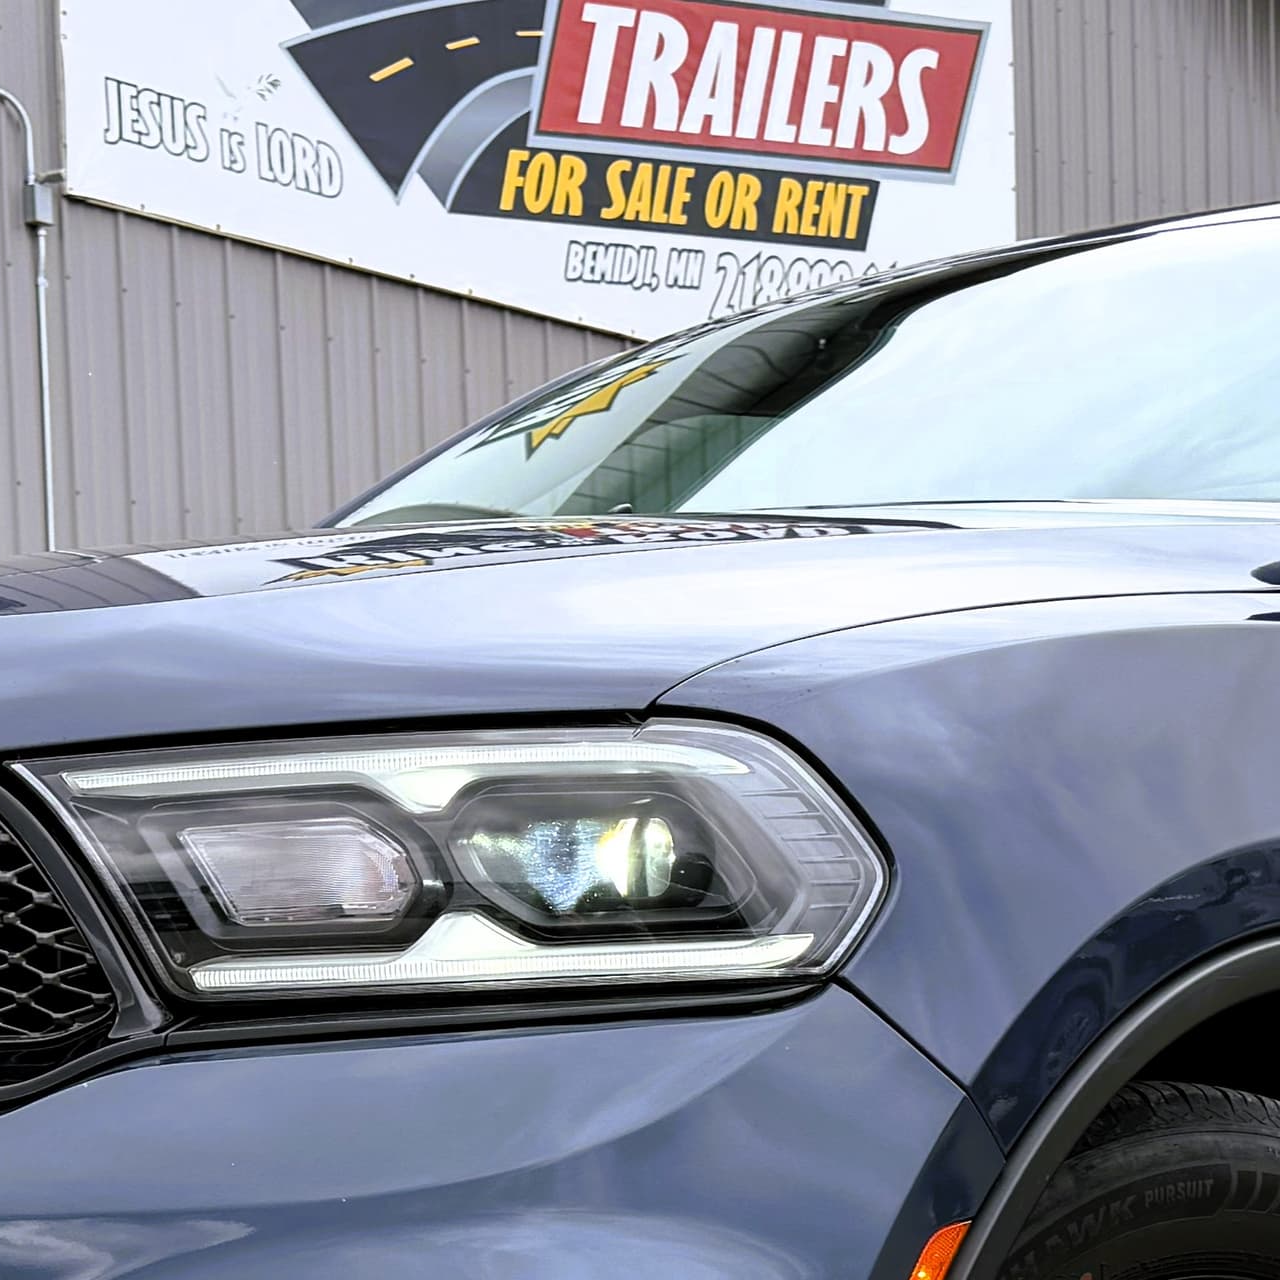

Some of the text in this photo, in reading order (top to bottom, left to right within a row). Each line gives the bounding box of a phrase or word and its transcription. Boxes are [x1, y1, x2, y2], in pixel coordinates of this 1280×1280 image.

[576, 2, 939, 156] TRAILERS
[104, 76, 209, 162] JESUS
[255, 121, 343, 198] LORD
[499, 149, 870, 240] FOR SALE OR RENT
[666, 247, 705, 289] MN
[1144, 1179, 1215, 1208] PURSUIT
